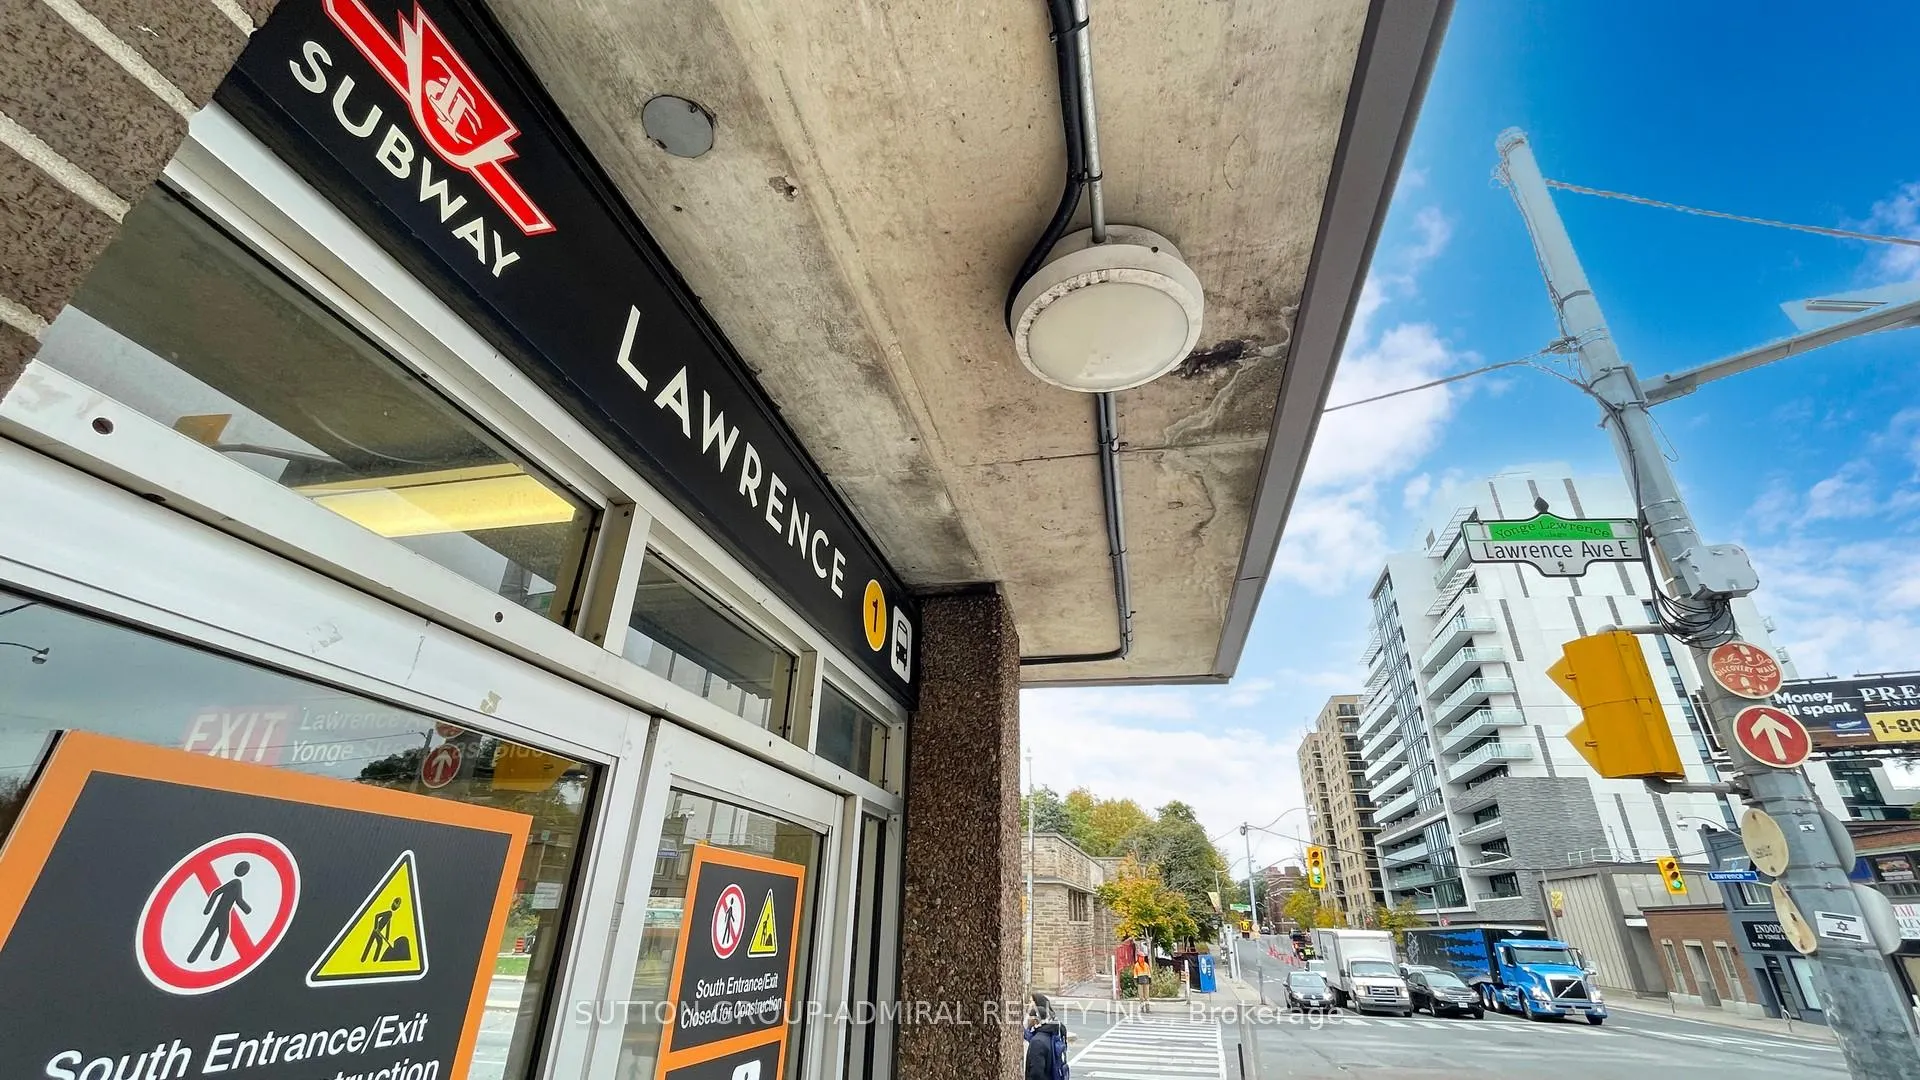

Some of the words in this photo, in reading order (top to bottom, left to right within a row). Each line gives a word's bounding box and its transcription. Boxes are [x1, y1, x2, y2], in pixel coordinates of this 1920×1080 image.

[289, 40, 521, 278] SUBWAY
[616, 304, 846, 600] LAWRENCE
[1496, 522, 1536, 539] Yonge
[1539, 520, 1611, 538] Lawrence
[1483, 542, 1573, 559] Lawrence
[1581, 541, 1615, 558] Ave
[1618, 540, 1632, 557] E
[872, 598, 879, 633] 1
[1715, 664, 1753, 677] DISCOVERY
[1756, 664, 1777, 674] WALK
[1773, 691, 1833, 704] Money
[1857, 684, 1920, 702] PRE
[1886, 699, 1920, 707] INJU
[1801, 701, 1859, 718] spent.
[184, 711, 290, 762] EXIT
[299, 708, 400, 731] Lawrence
[291, 739, 354, 767] Yonge
[696, 979, 725, 998] South
[727, 973, 778, 994] Entrance/Exit
[681, 1003, 718, 1029] Closed
[718, 1004, 733, 1021] for
[734, 996, 782, 1018] Construction
[45, 1036, 193, 1080] South
[201, 1011, 430, 1075] Entrance/Exit
